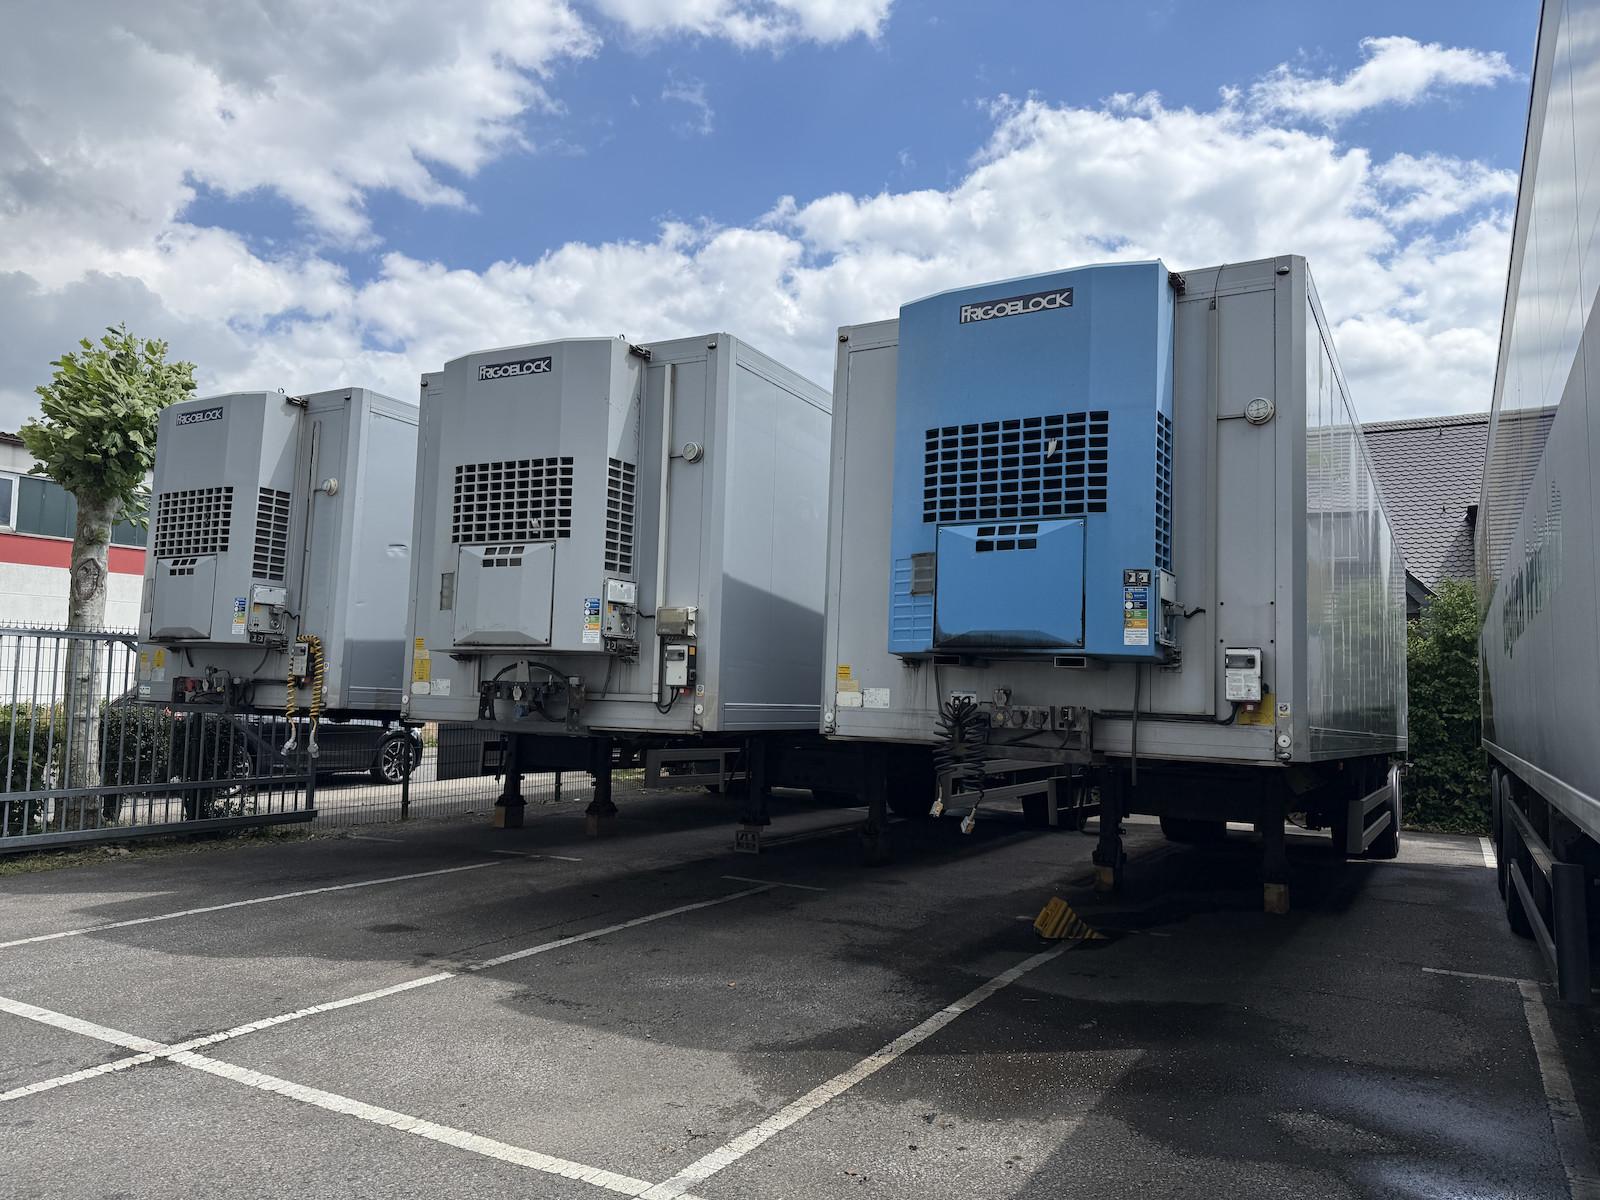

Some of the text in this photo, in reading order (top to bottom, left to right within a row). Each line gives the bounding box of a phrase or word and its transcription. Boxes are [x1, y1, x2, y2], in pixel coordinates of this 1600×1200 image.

[962, 292, 1071, 323] FRIGOBLOCK
[479, 360, 550, 379] FRIGOBLOCK
[177, 409, 222, 425] FRIGOBLOCK
